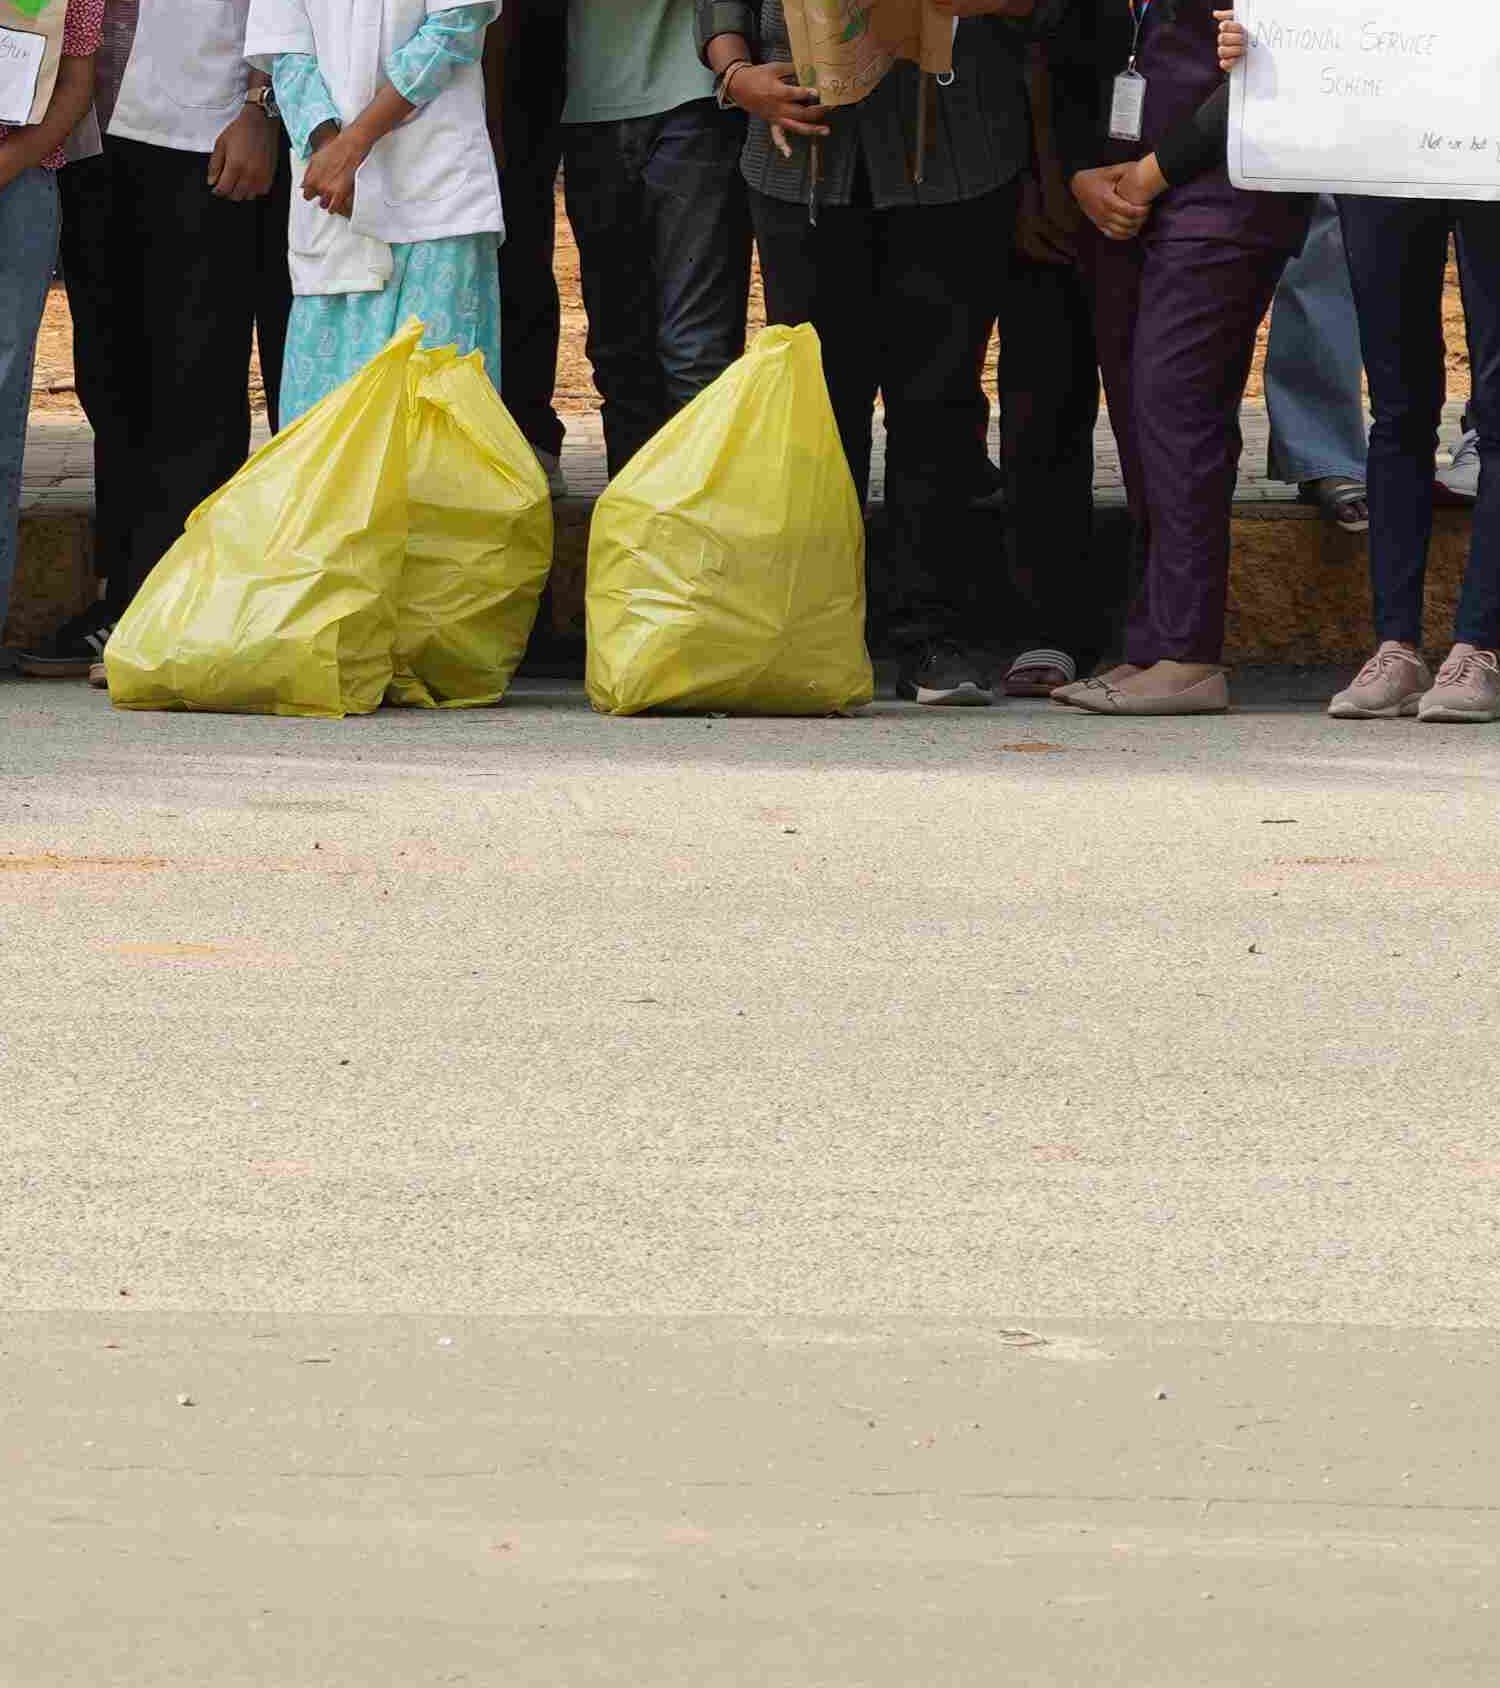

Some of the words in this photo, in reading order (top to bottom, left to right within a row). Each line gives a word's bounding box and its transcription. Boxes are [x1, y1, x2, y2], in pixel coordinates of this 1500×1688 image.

[1254, 19, 1341, 50] NATIONAL
[1359, 20, 1441, 56] SERVICE
[1320, 65, 1384, 97] SCHEME
